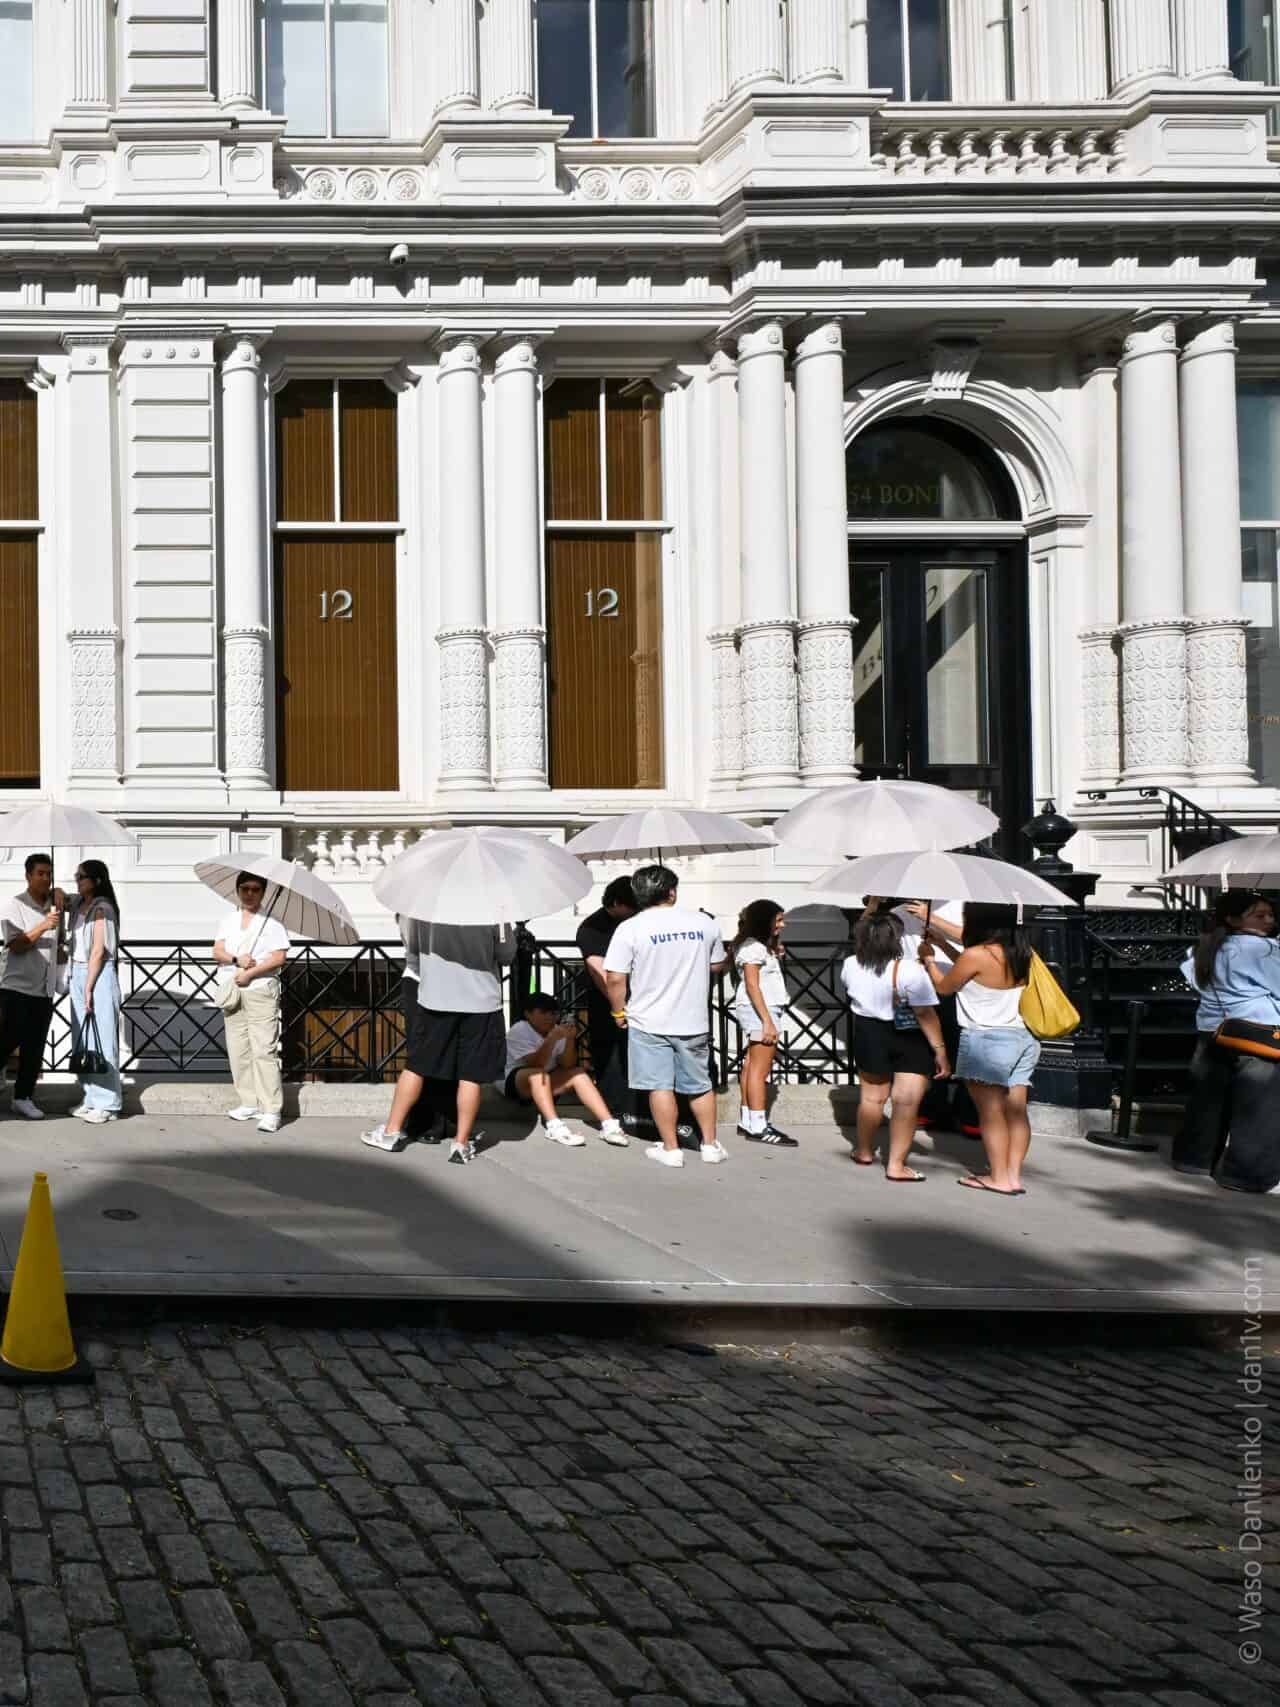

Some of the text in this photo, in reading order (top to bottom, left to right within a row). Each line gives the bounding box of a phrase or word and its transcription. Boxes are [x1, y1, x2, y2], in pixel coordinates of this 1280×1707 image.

[847, 484, 873, 505] 54
[319, 589, 353, 619] 12
[583, 587, 619, 617] 12
[651, 930, 704, 944] VUITTON
